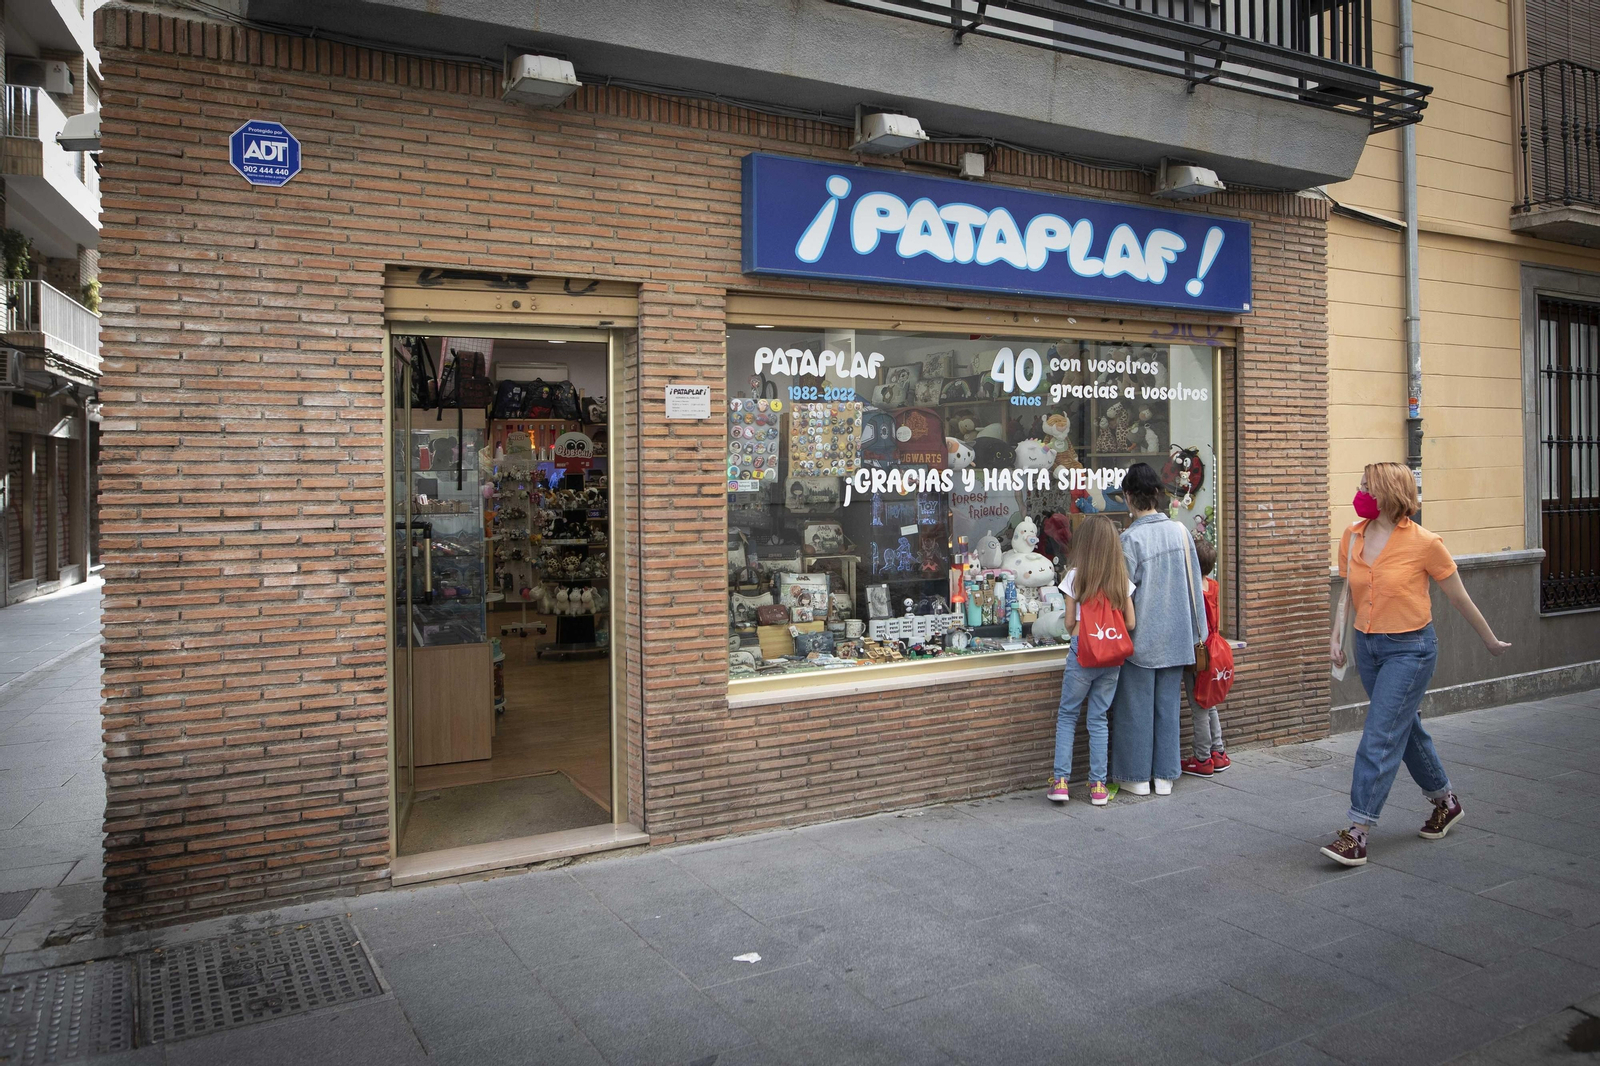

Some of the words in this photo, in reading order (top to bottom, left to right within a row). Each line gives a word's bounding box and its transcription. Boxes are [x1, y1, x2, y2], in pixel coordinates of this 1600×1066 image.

[244, 140, 288, 162] ADT
[754, 346, 885, 379] PATAPLAF
[990, 347, 1042, 393] 40
[1050, 358, 1081, 372] con
[1088, 355, 1158, 375] vosotros
[788, 386, 856, 401] 1982-2022
[1010, 392, 1042, 406] años
[1050, 380, 1118, 403] gracias
[1124, 386, 1135, 400] a
[1142, 382, 1208, 401] vosotros
[844, 468, 954, 507] ¡GRACIAS
[983, 468, 1050, 491] HASTA
[1058, 467, 1130, 490] SIEMPR
[920, 500, 938, 510] TOY
